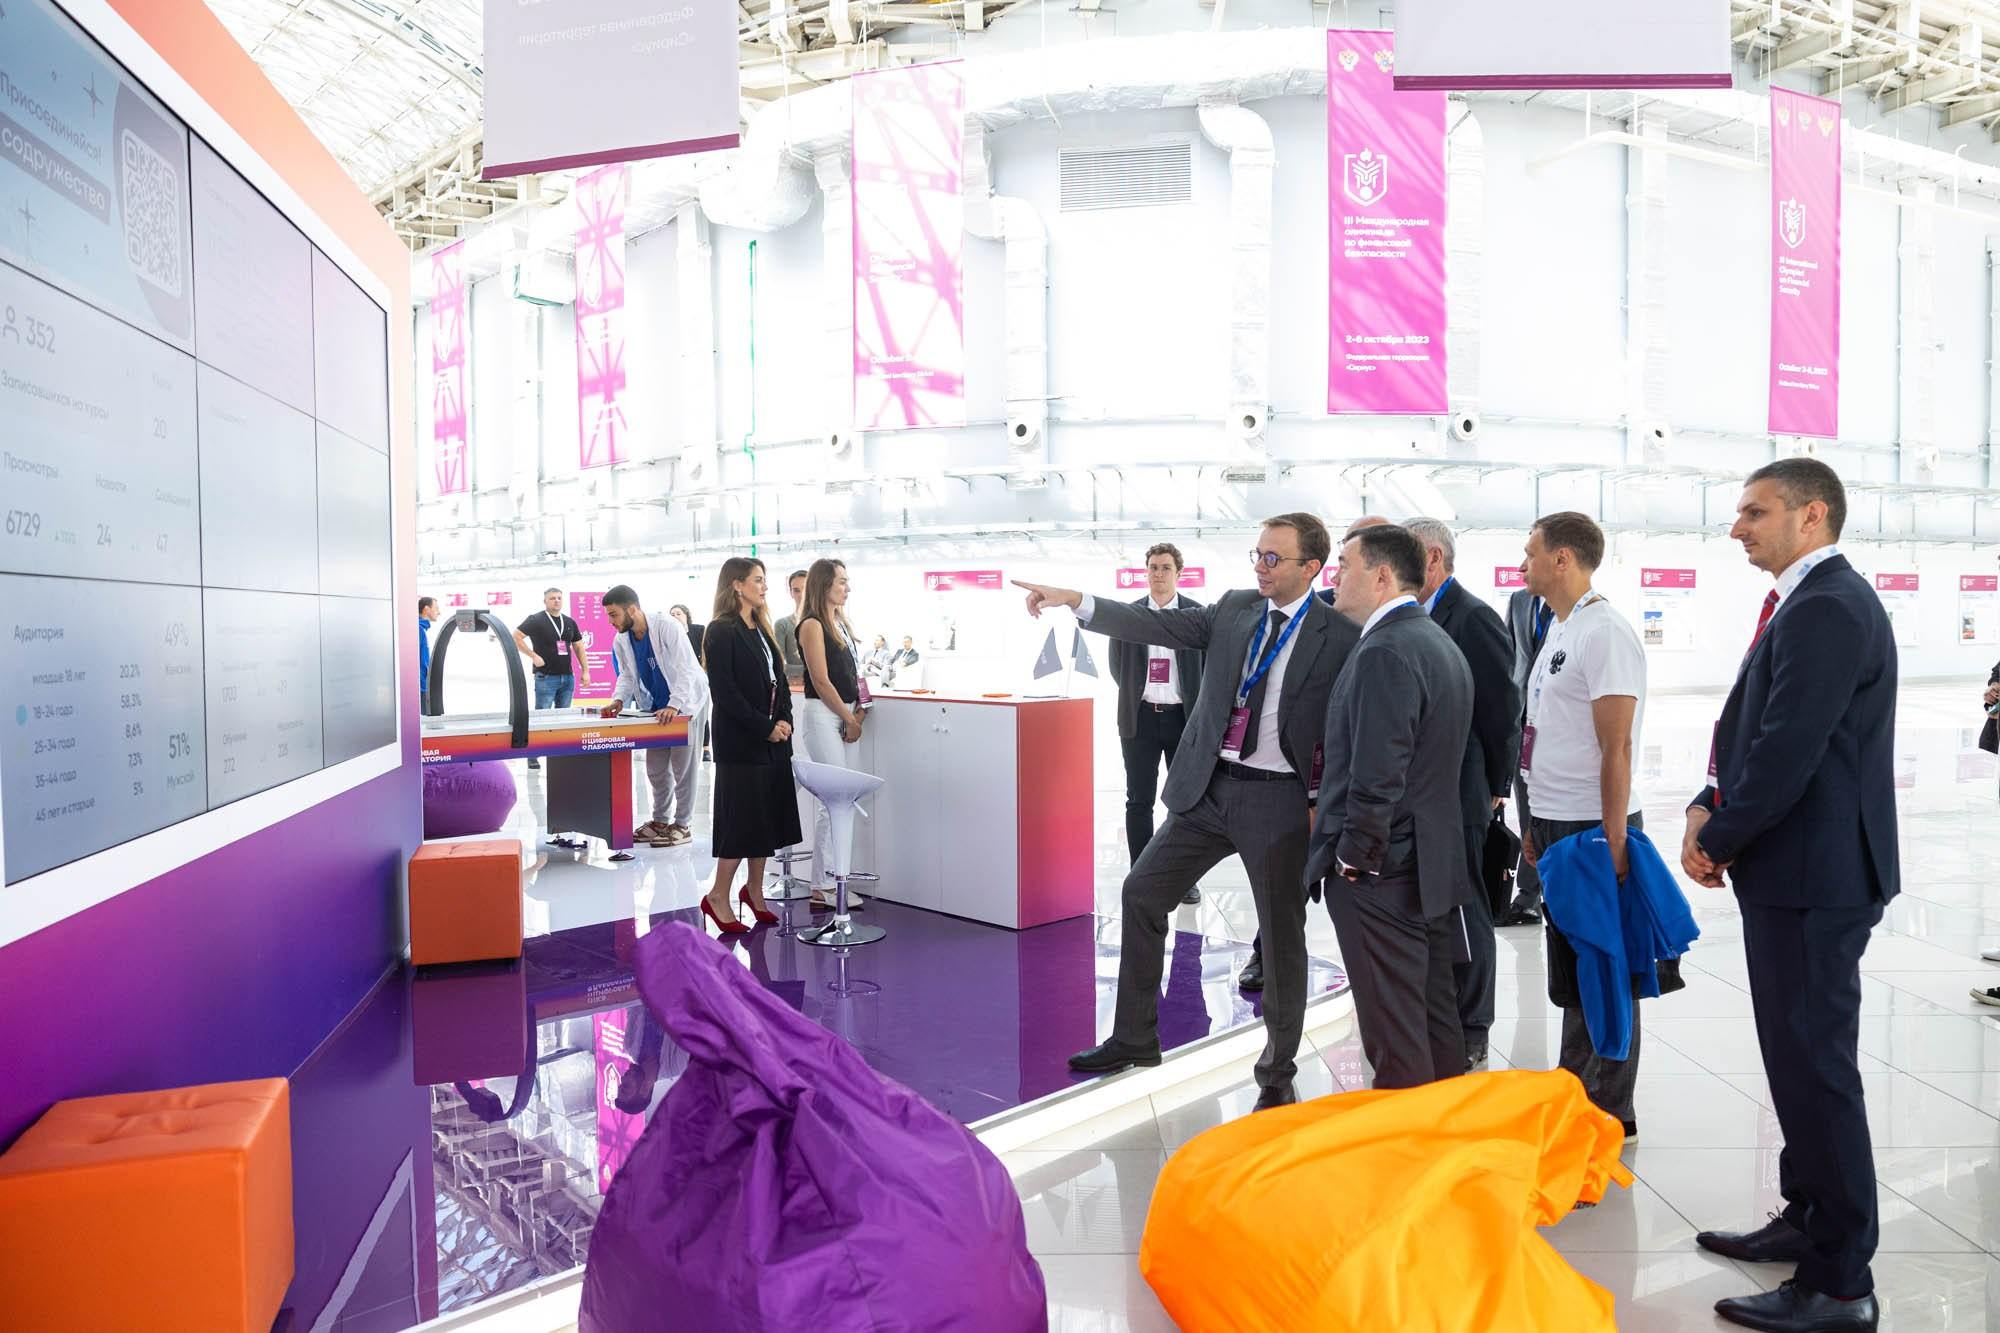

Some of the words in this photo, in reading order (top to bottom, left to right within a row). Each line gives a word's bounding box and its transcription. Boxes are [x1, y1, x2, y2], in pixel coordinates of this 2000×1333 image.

[0, 70, 103, 168] Присоединяйся!
[1, 126, 105, 210] содружество
[25, 315, 57, 355] 352
[1405, 335, 1430, 344] 2023
[3, 450, 59, 481] Просмотры
[5, 507, 42, 539] 6729
[96, 522, 112, 547] 24
[14, 625, 65, 645] Аудитория
[120, 692, 143, 710] 58,3%
[35, 738, 57, 755] 25-34
[168, 731, 192, 761] 51%
[587, 742, 636, 751] ЛАБОРАТОРИЯ
[36, 772, 59, 789] 35-44
[36, 807, 47, 822] 45
